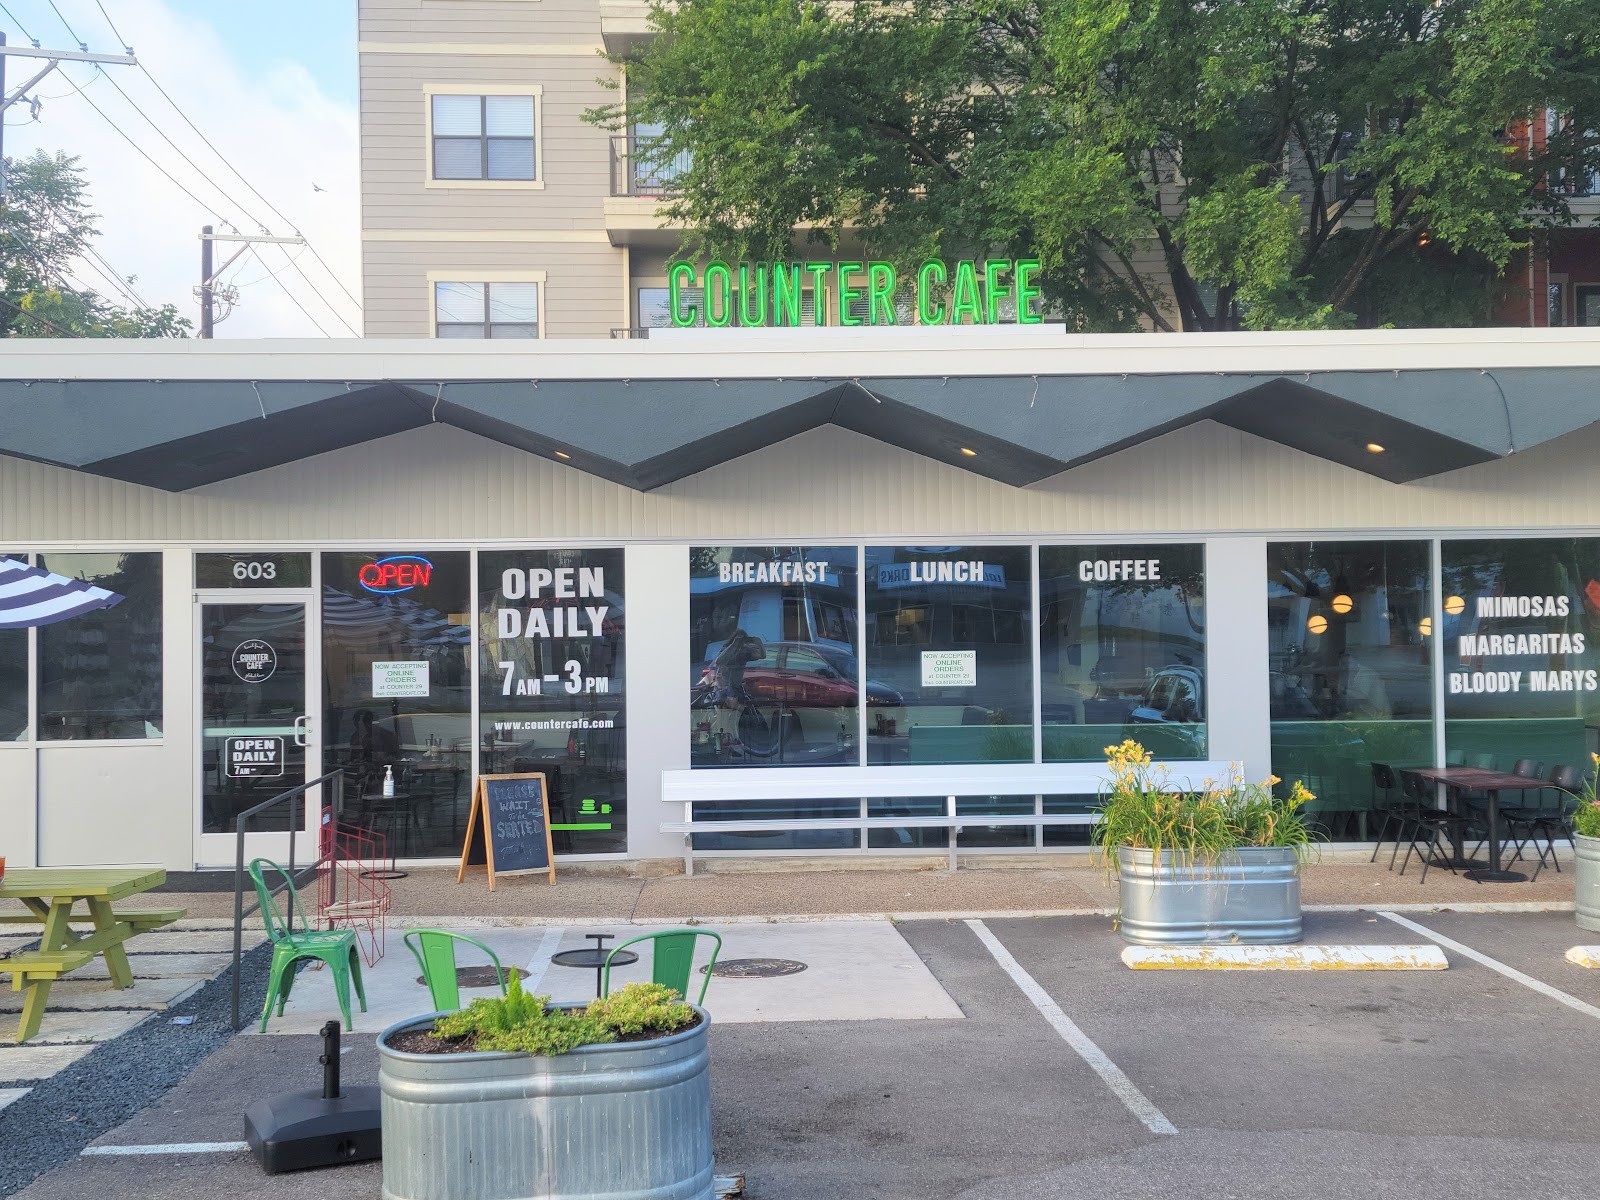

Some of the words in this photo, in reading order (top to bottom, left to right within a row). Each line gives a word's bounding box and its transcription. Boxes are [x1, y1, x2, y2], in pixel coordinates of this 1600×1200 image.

[669, 260, 896, 327] COUNTER
[917, 259, 1043, 324] CAFE
[233, 562, 276, 580] 603
[359, 564, 430, 587] OPEN
[719, 561, 828, 583] BREAKFAST
[910, 560, 984, 582] LUNCH
[1078, 559, 1161, 582] COFFEE
[502, 567, 605, 600] OPEN
[1478, 595, 1570, 617] MIMOSAS
[498, 606, 609, 639] DAILY
[1459, 633, 1586, 656] MARGARITAS
[1450, 671, 1522, 693] BLOODY
[1530, 670, 1598, 692] MARYS
[495, 718, 614, 731] www.countercafe.com
[235, 740, 274, 750] OPEN
[233, 751, 276, 762] DAILY
[499, 801, 530, 811] WAIT
[496, 819, 543, 839] SEATED
